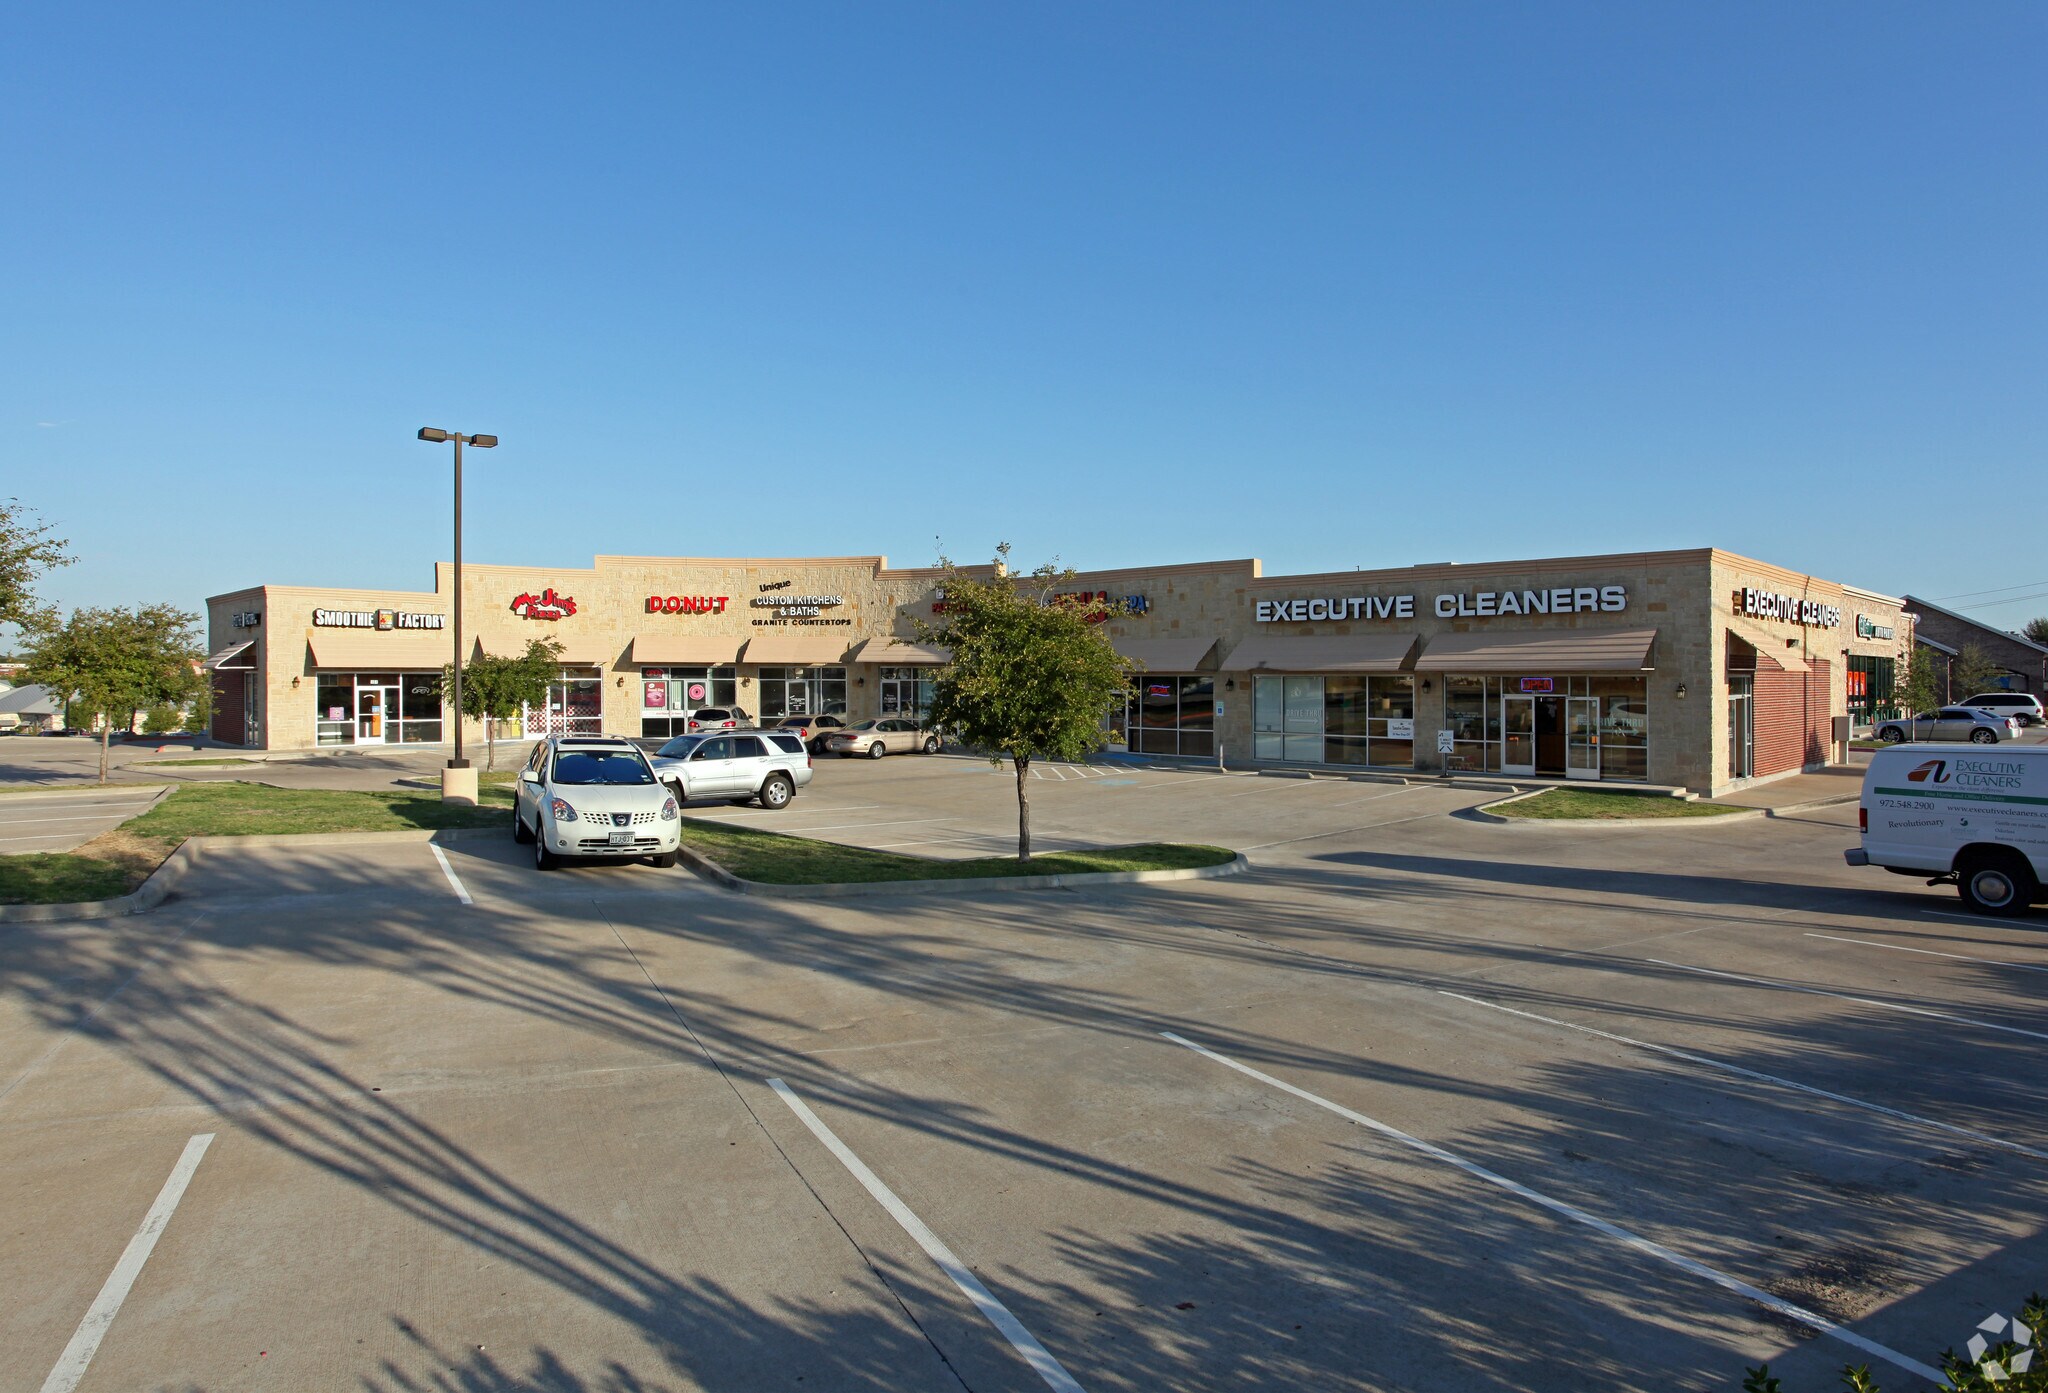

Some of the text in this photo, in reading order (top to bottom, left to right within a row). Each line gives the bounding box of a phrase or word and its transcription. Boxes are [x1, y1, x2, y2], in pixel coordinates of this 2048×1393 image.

[759, 580, 791, 592] Unique
[541, 588, 577, 615] Jim's
[650, 596, 729, 611] DONUT
[756, 595, 794, 605] CUSTOM
[1256, 586, 1627, 622] EXECUTIVE CLEANERS
[780, 606, 787, 616] &
[1746, 588, 1798, 621] EXECUTIVE
[1802, 600, 1840, 628] CLEANERS
[315, 608, 374, 627] SMOOTHIE
[398, 611, 446, 629] FACTORY
[412, 686, 430, 694] OPEN
[1522, 679, 1551, 690] OPEN
[1285, 708, 1321, 717] DRIVE THRU
[1621, 718, 1643, 727] THRU
[1955, 759, 2025, 774] EXECUTIVE
[1956, 773, 2021, 788] CLEANERS
[1879, 799, 1935, 810] 972.548.2900
[1888, 819, 1945, 828] Revolutionary
